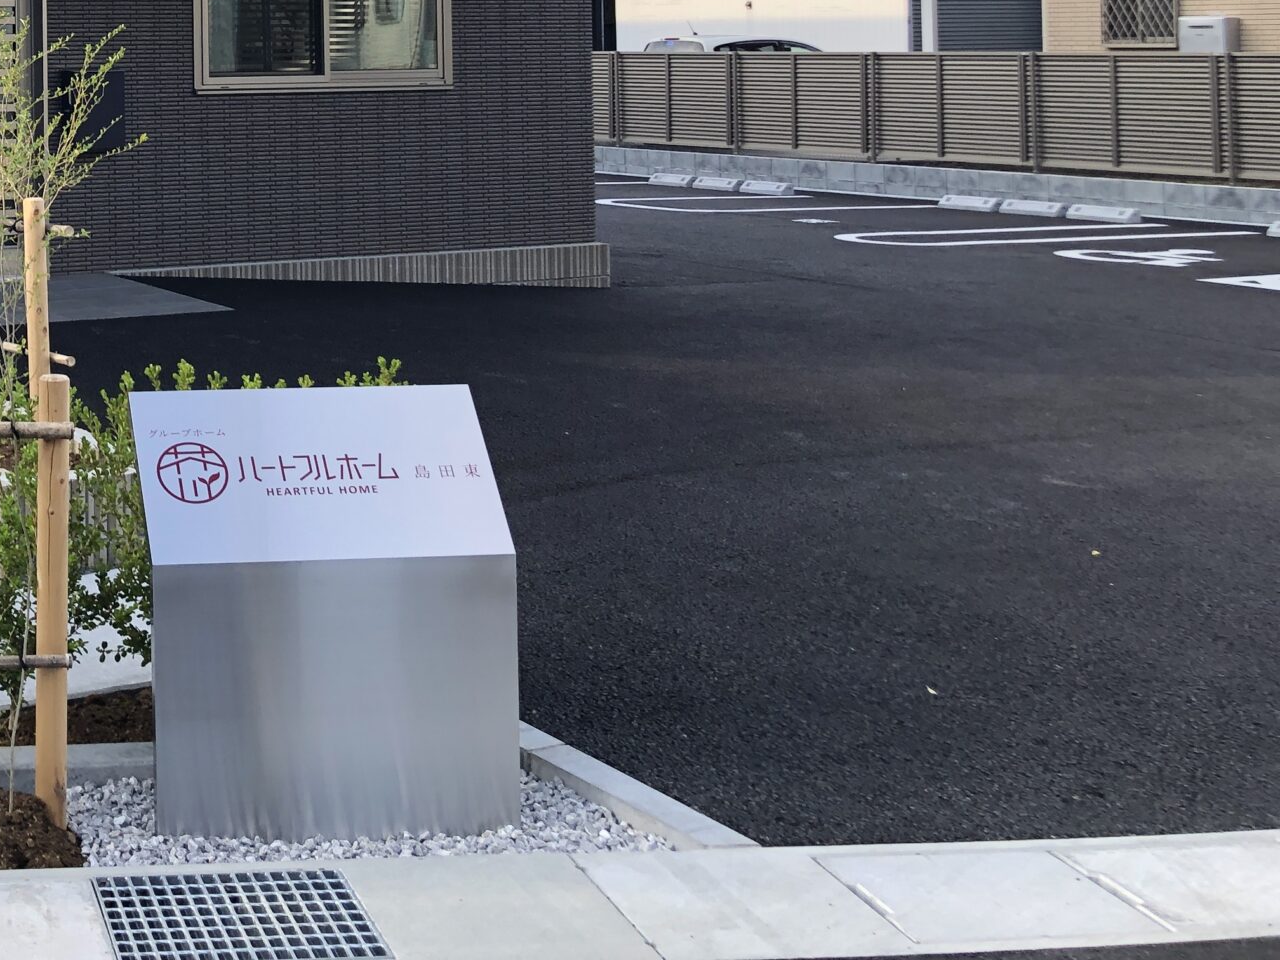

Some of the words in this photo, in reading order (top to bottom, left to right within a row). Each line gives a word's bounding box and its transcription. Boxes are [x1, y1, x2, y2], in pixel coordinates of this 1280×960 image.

[149, 428, 226, 438] グループホーム
[238, 453, 400, 482] ハートフルホーム
[414, 463, 481, 480] 島田東
[266, 486, 333, 497] HEARTFUL
[339, 484, 379, 495] HOME
